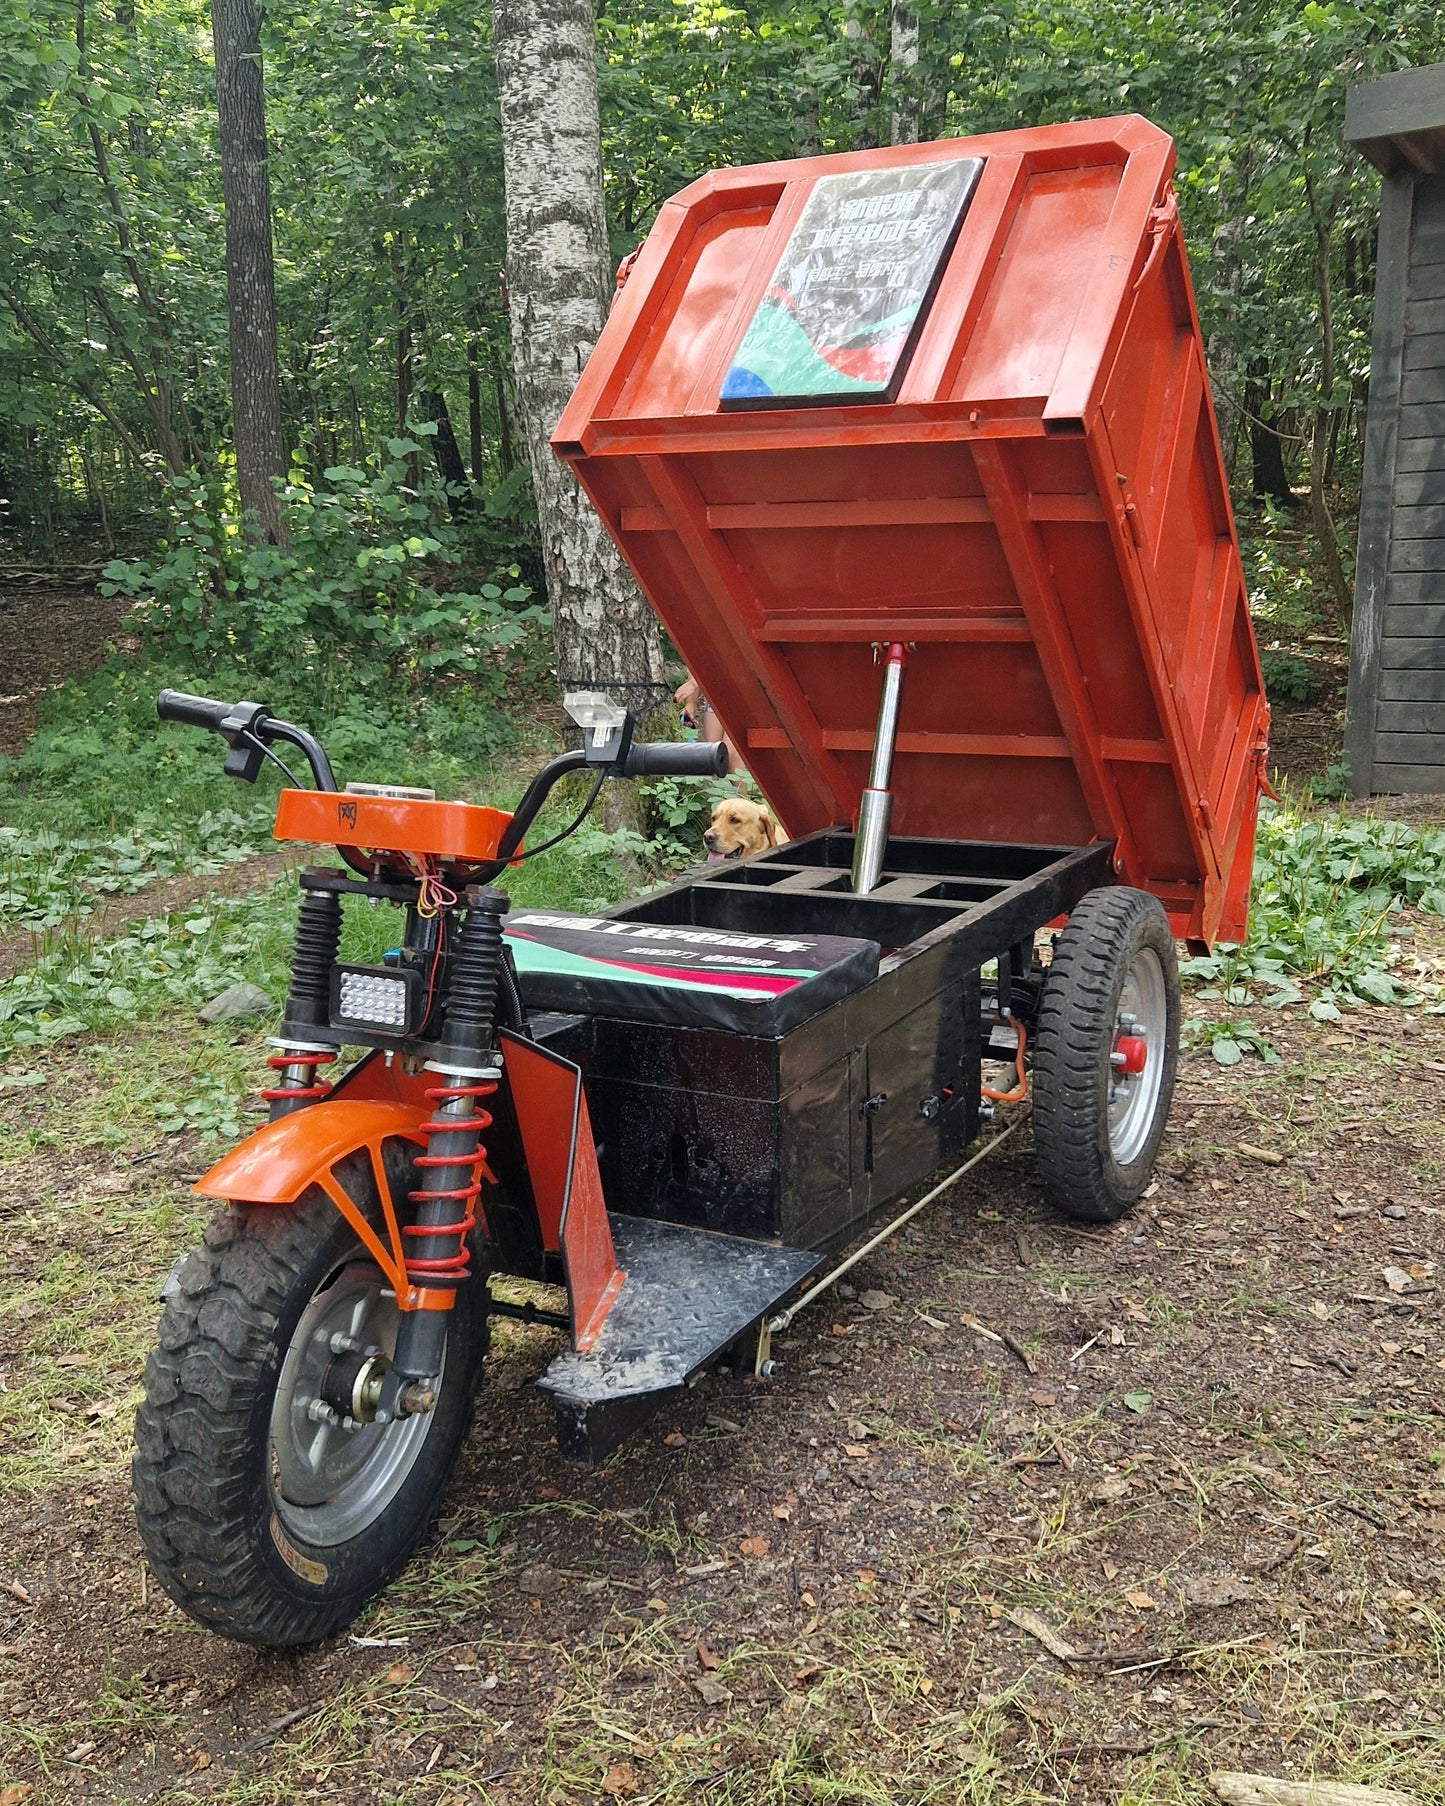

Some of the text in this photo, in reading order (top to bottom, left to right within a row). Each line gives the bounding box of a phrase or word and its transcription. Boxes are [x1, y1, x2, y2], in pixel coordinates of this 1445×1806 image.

[839, 191, 922, 219] 新能源
[807, 216, 937, 249] 工程电动车
